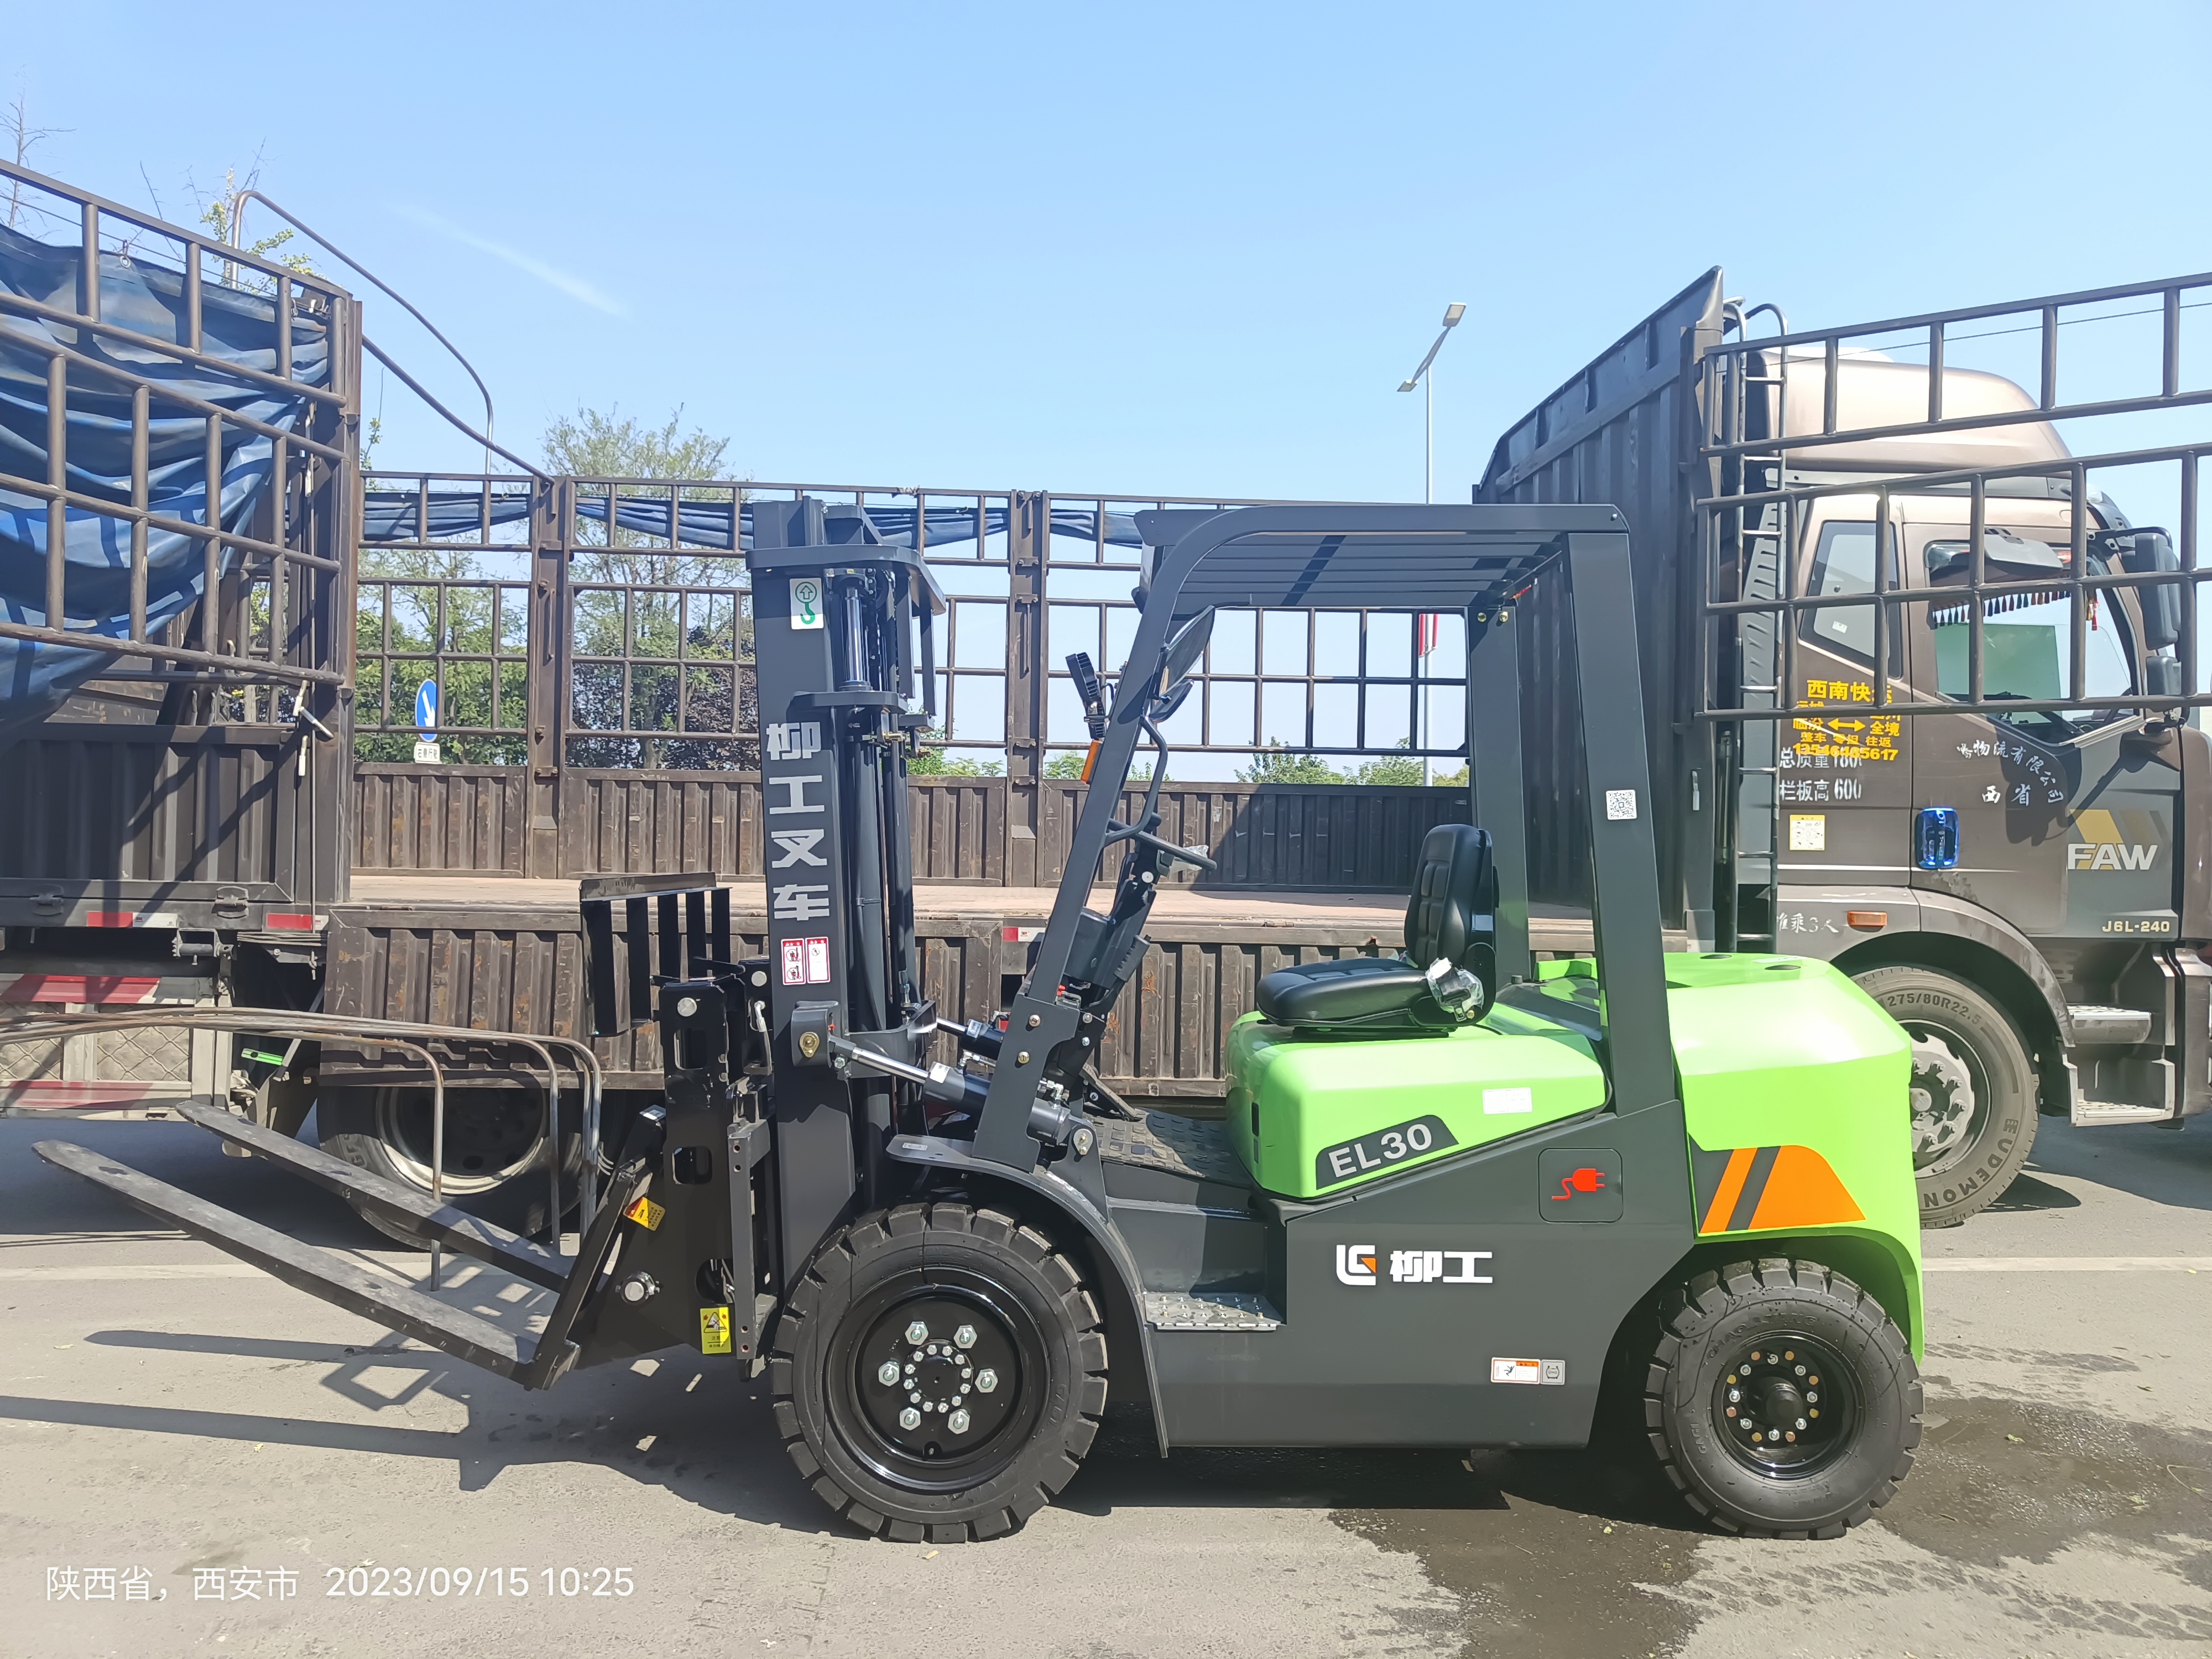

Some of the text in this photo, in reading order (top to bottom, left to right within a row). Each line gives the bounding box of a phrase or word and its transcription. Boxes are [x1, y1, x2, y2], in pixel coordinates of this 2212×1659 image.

[766, 722, 830, 921] 柳工叉车
[2068, 844, 2158, 870] FAW
[2102, 921, 2170, 932] J6L-240
[1886, 993, 1983, 1026] 275/80R22.5
[1328, 1124, 1432, 1178] EL30
[1923, 1118, 2019, 1208] EUDEMON
[1390, 1250, 1493, 1283] 柳工
